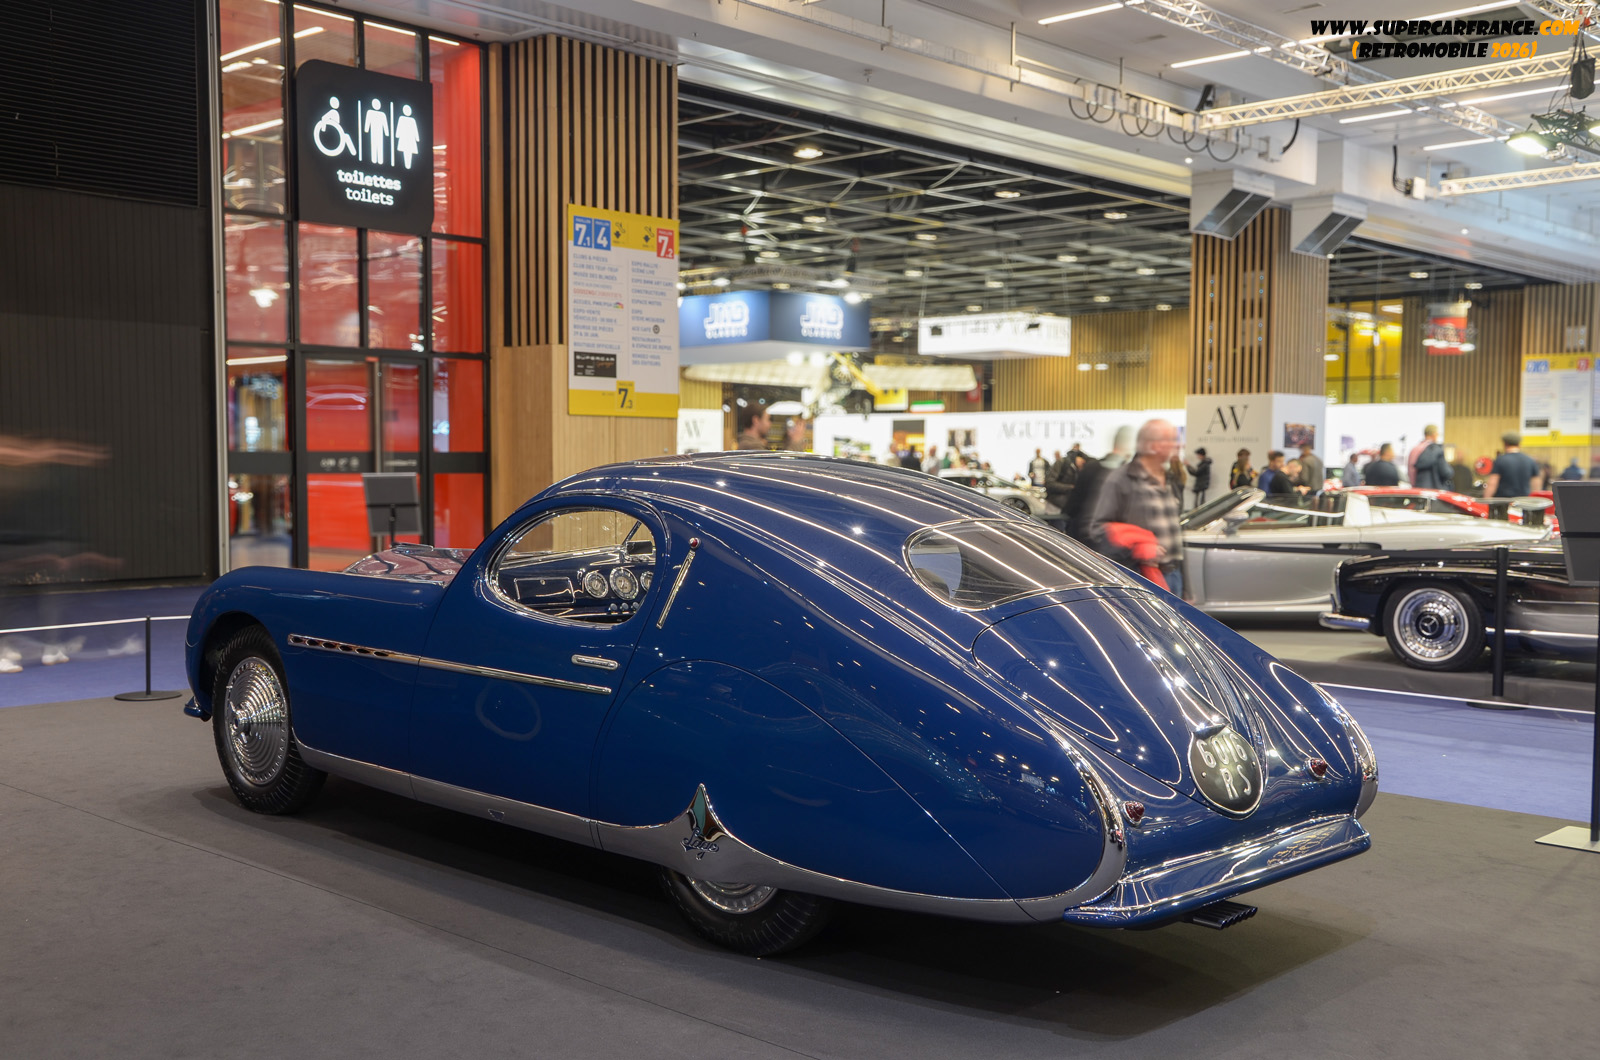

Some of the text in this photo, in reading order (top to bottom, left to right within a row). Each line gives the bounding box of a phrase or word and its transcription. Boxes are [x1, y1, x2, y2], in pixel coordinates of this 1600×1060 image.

[336, 169, 402, 191] toilettes
[345, 187, 394, 206] toilets
[597, 226, 608, 248] 4
[658, 235, 673, 258] 7.2
